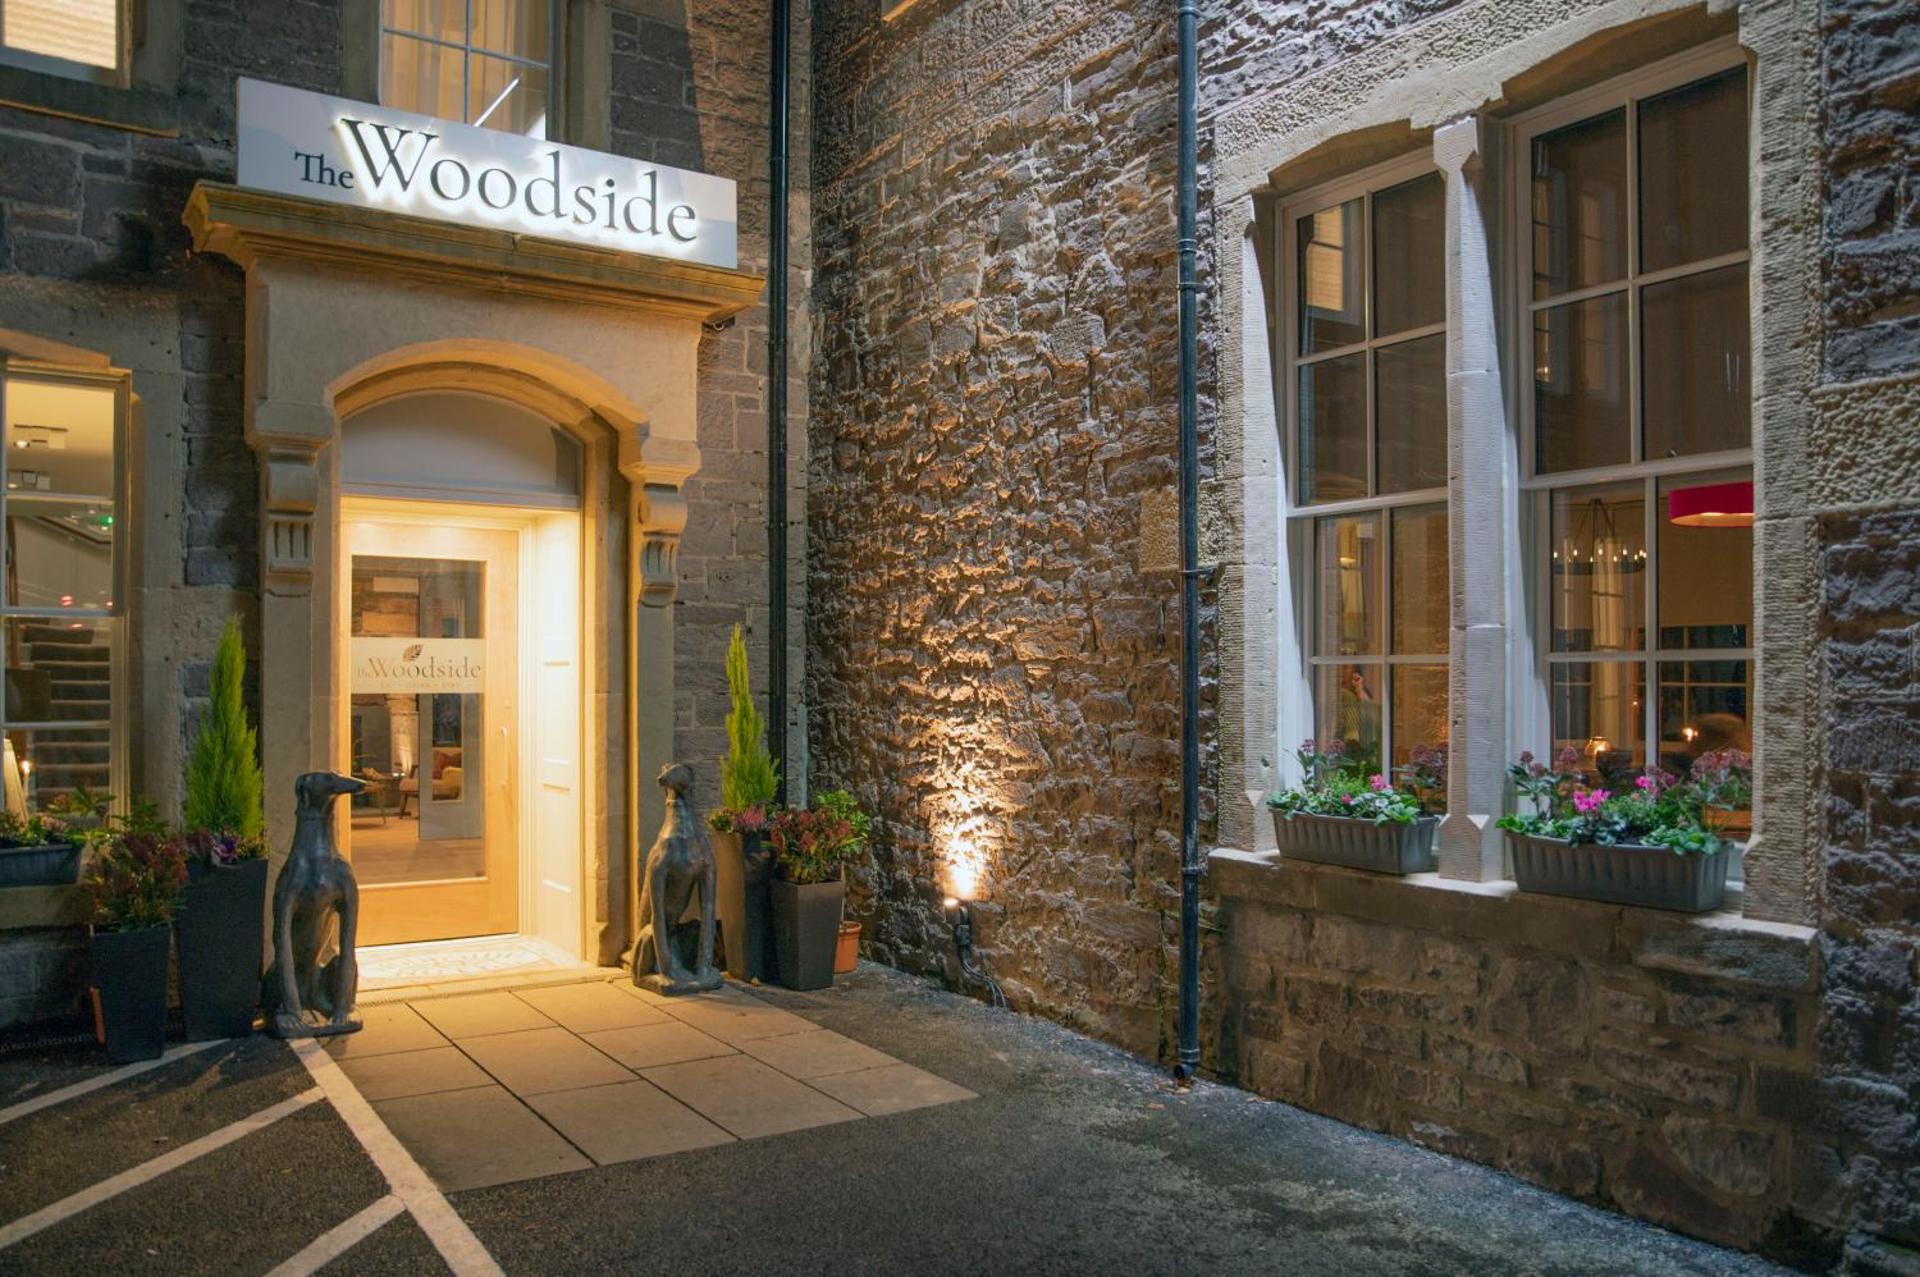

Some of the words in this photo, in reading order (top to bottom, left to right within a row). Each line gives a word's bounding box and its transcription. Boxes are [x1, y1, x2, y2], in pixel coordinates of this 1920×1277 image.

[294, 151, 354, 190] The
[340, 118, 697, 242] Woodside
[368, 656, 481, 679] Woodside
